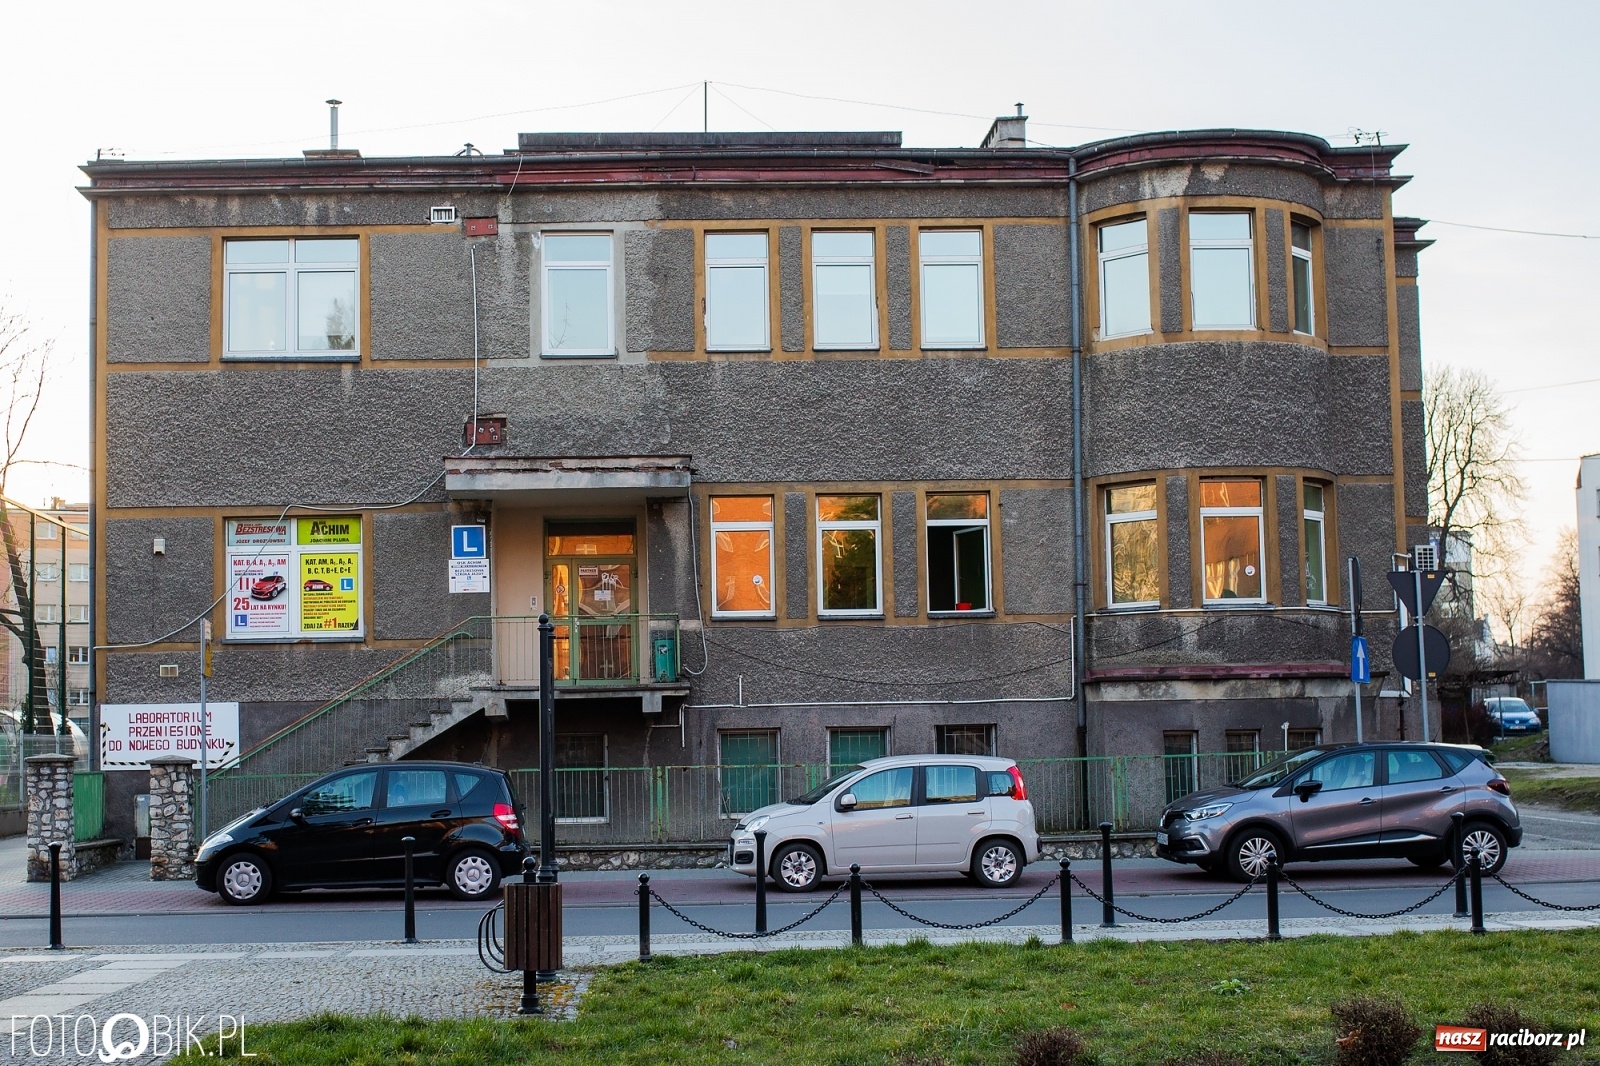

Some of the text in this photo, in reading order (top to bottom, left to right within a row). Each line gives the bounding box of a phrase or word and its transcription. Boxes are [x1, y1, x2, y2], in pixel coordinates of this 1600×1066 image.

[310, 521, 350, 535] ACHIM
[463, 531, 478, 552] L
[276, 558, 287, 566] AM
[305, 558, 318, 566] KAT.
[233, 597, 250, 611] 25
[324, 617, 337, 629] #1
[128, 711, 212, 724] LABORATORIUM
[128, 725, 212, 737] PRZENIESIONE
[108, 738, 225, 751] DO NOWEGO BUDYNKU
